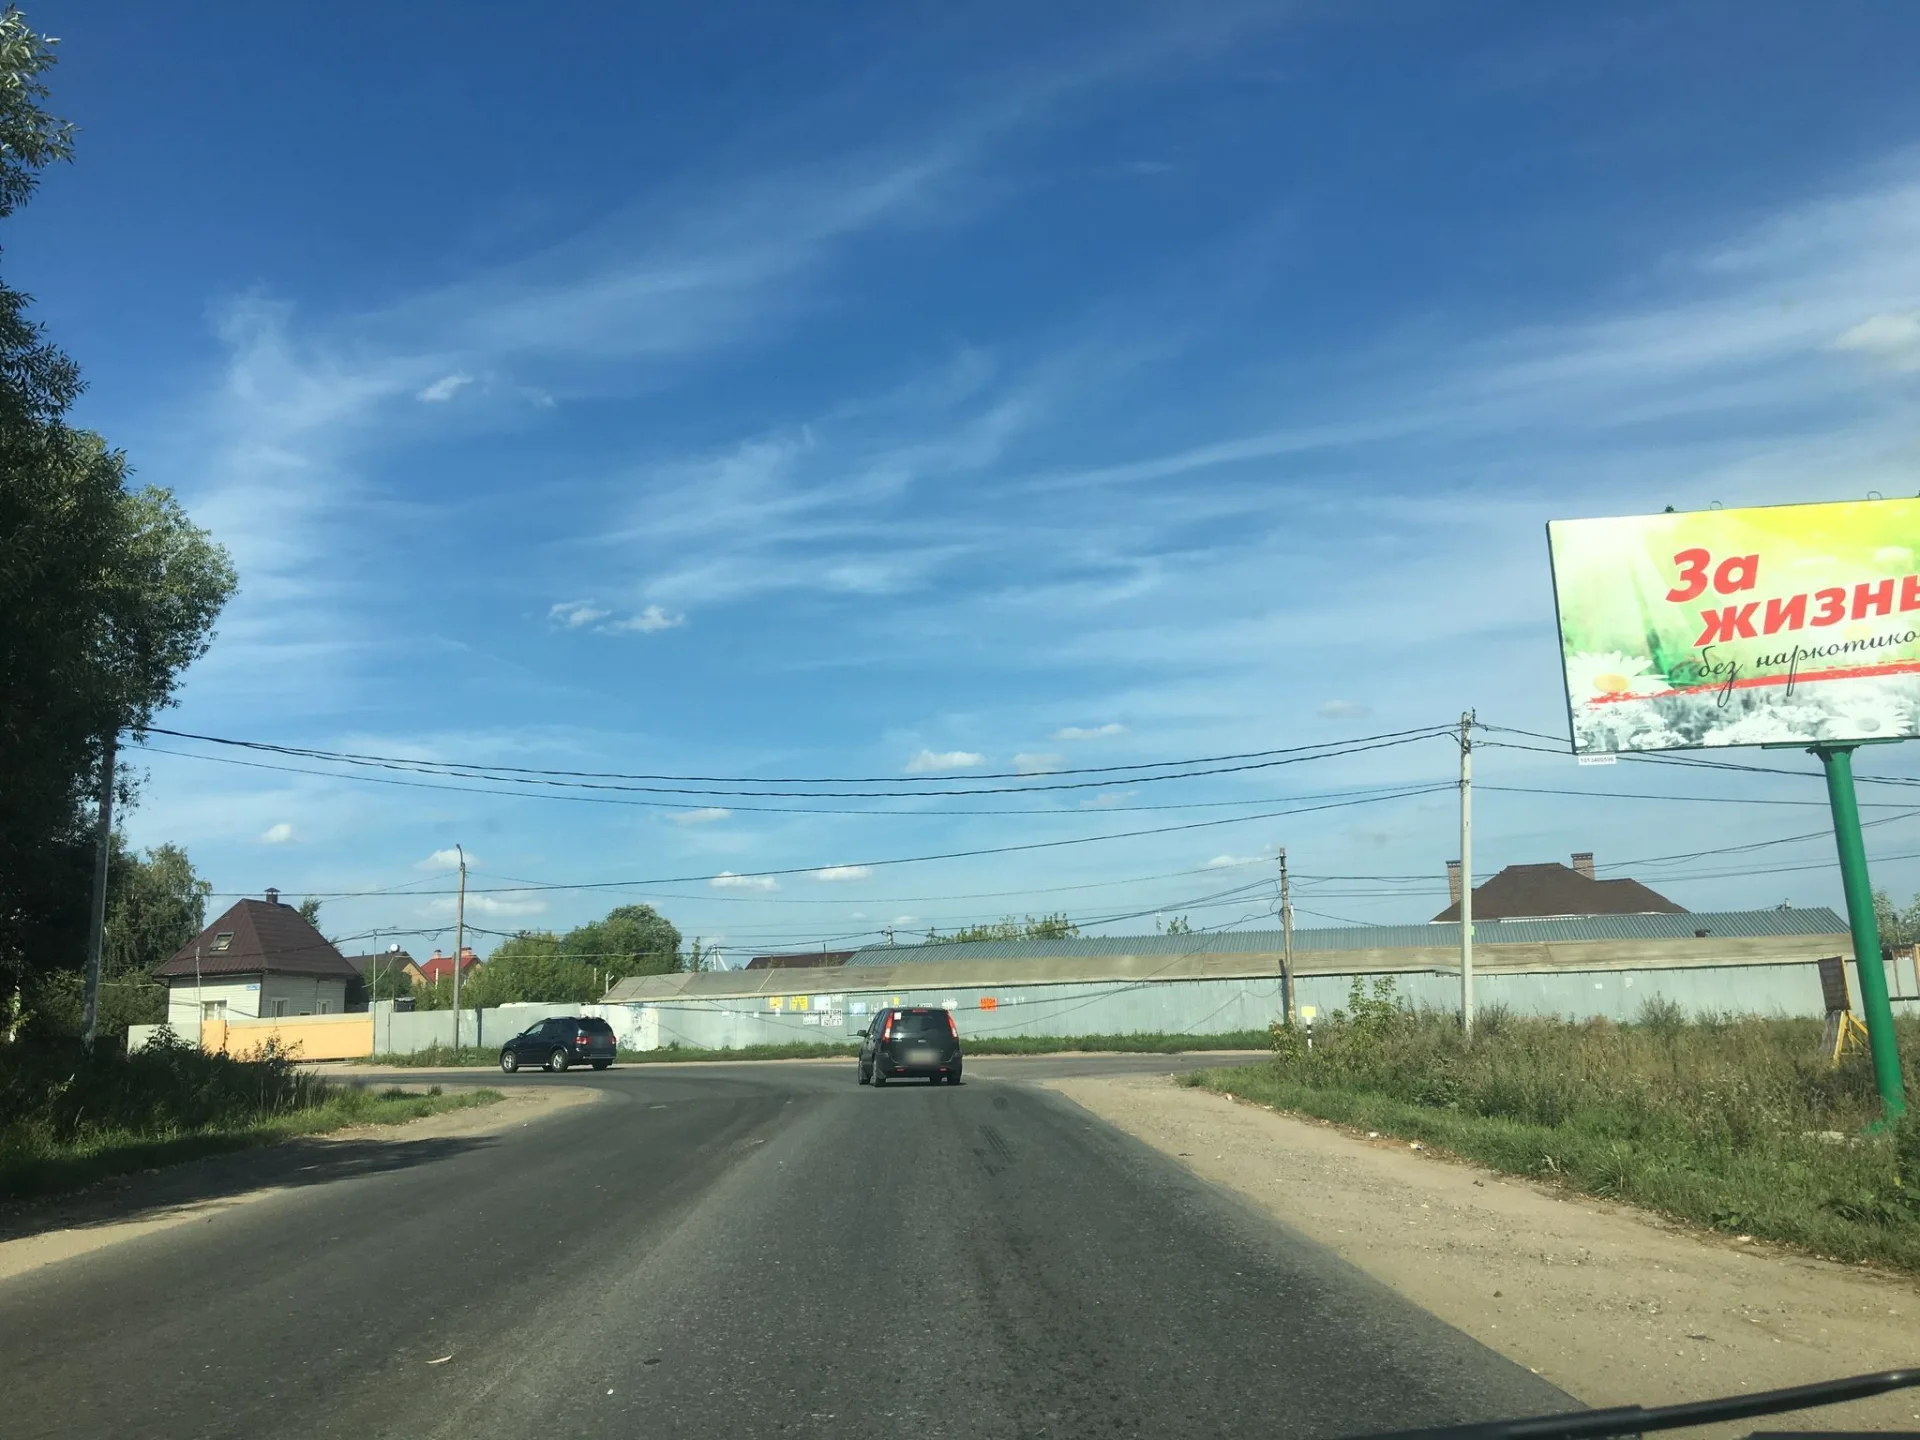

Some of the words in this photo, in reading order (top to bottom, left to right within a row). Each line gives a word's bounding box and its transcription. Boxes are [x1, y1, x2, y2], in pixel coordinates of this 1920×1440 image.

[1665, 548, 1759, 603] За
[1699, 645, 1743, 708] без
[1756, 630, 1920, 697] наркотико
